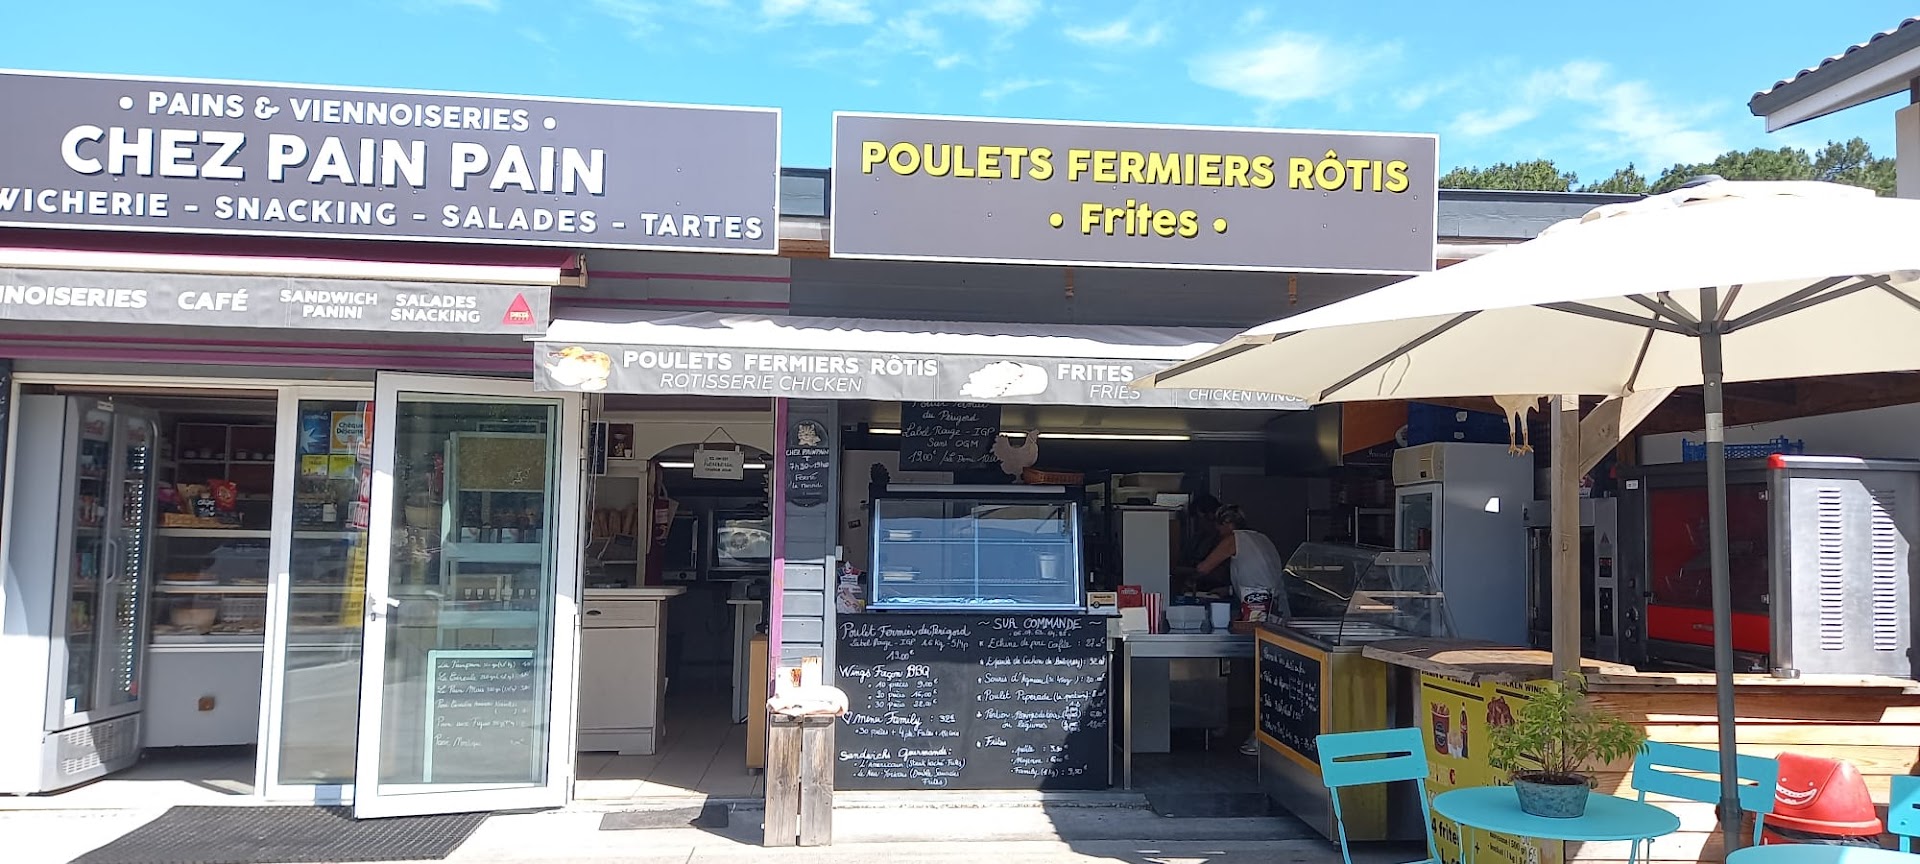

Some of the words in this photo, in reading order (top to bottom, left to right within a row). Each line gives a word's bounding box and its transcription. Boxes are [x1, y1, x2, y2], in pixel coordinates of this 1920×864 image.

[148, 91, 244, 118] PAINS
[254, 97, 280, 120] &
[290, 98, 529, 132] VIENNOISERIES
[61, 125, 246, 181] CHEZ
[268, 133, 427, 188] PAIN
[451, 141, 606, 196] PAIN
[862, 140, 1054, 181] POULETS
[1067, 149, 1276, 189] FERMIERS
[1287, 149, 1410, 193] RÔTIS
[214, 195, 397, 226] SNACKING
[442, 205, 597, 233] SALADES
[641, 213, 763, 240] TARTES
[1081, 199, 1199, 238] Frites
[0, 285, 147, 309] NOISERIES
[177, 289, 249, 312] CAFÉ
[280, 289, 378, 306] SANDWICH
[395, 293, 477, 308] SALADES
[303, 304, 363, 319] PANINI
[391, 307, 481, 323] SNACKING
[623, 350, 732, 371] POULETS
[744, 354, 860, 374] FERMIERS
[870, 354, 938, 377] RÔTIS
[1057, 363, 1135, 383] FRITES
[660, 372, 776, 390] ROTISSERIE
[779, 376, 863, 392] CHICKEN
[1089, 384, 1141, 400] FRIES
[1188, 388, 1252, 401] CHICKEN
[971, 427, 996, 436] IGP
[955, 440, 980, 448] OGM
[840, 622, 876, 640] Poulet
[877, 624, 918, 638] Fermier
[992, 617, 1018, 630] SUR
[1023, 617, 1082, 631] COMMANDE
[839, 664, 871, 683] Wings
[905, 664, 930, 679] BBQ
[984, 689, 1012, 701] Poulet
[852, 713, 884, 724] Menu
[884, 711, 923, 731] Family
[1439, 821, 1460, 848] frite
